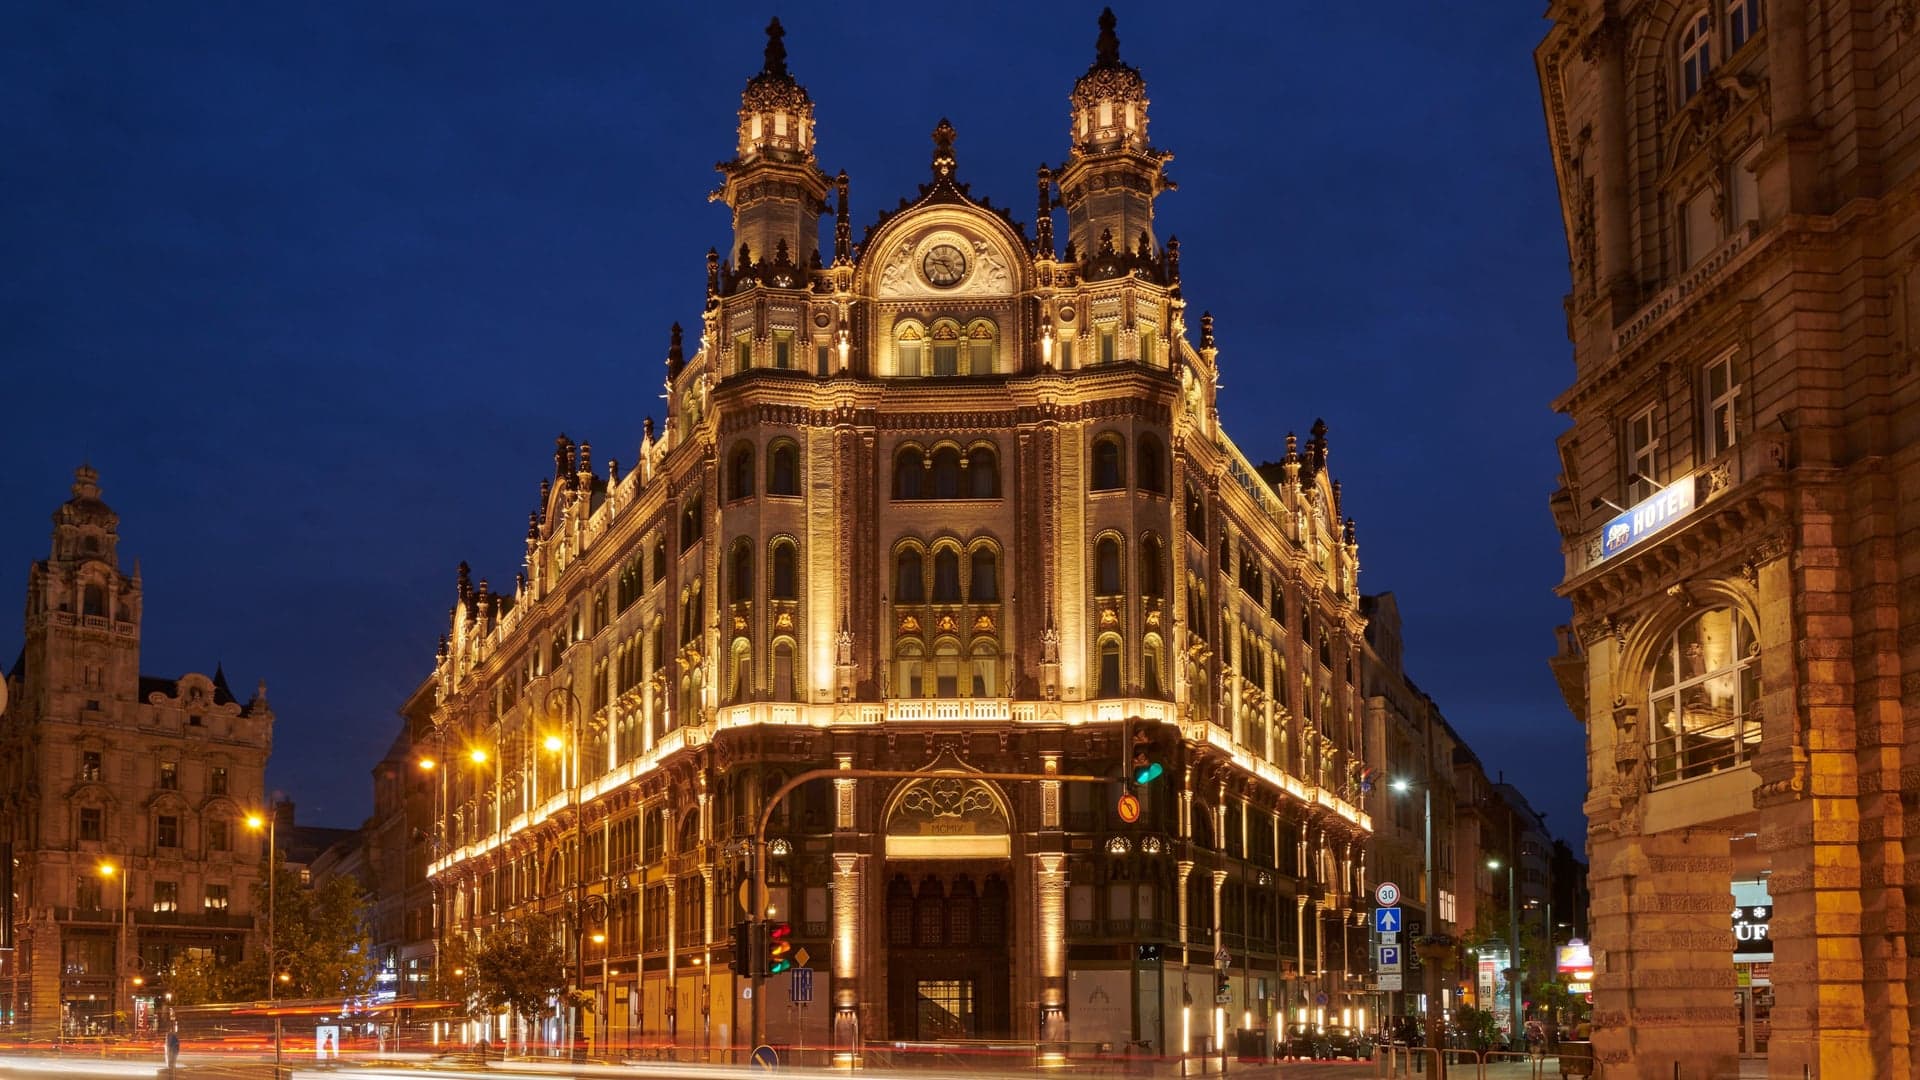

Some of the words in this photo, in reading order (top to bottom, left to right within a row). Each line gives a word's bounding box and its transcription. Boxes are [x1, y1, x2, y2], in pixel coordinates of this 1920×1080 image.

[1633, 485, 1689, 536] HOTEL
[1609, 533, 1630, 551] LEO
[1382, 890, 1394, 899] 30
[1731, 921, 1769, 941] ÜF
[1383, 948, 1394, 964] P
